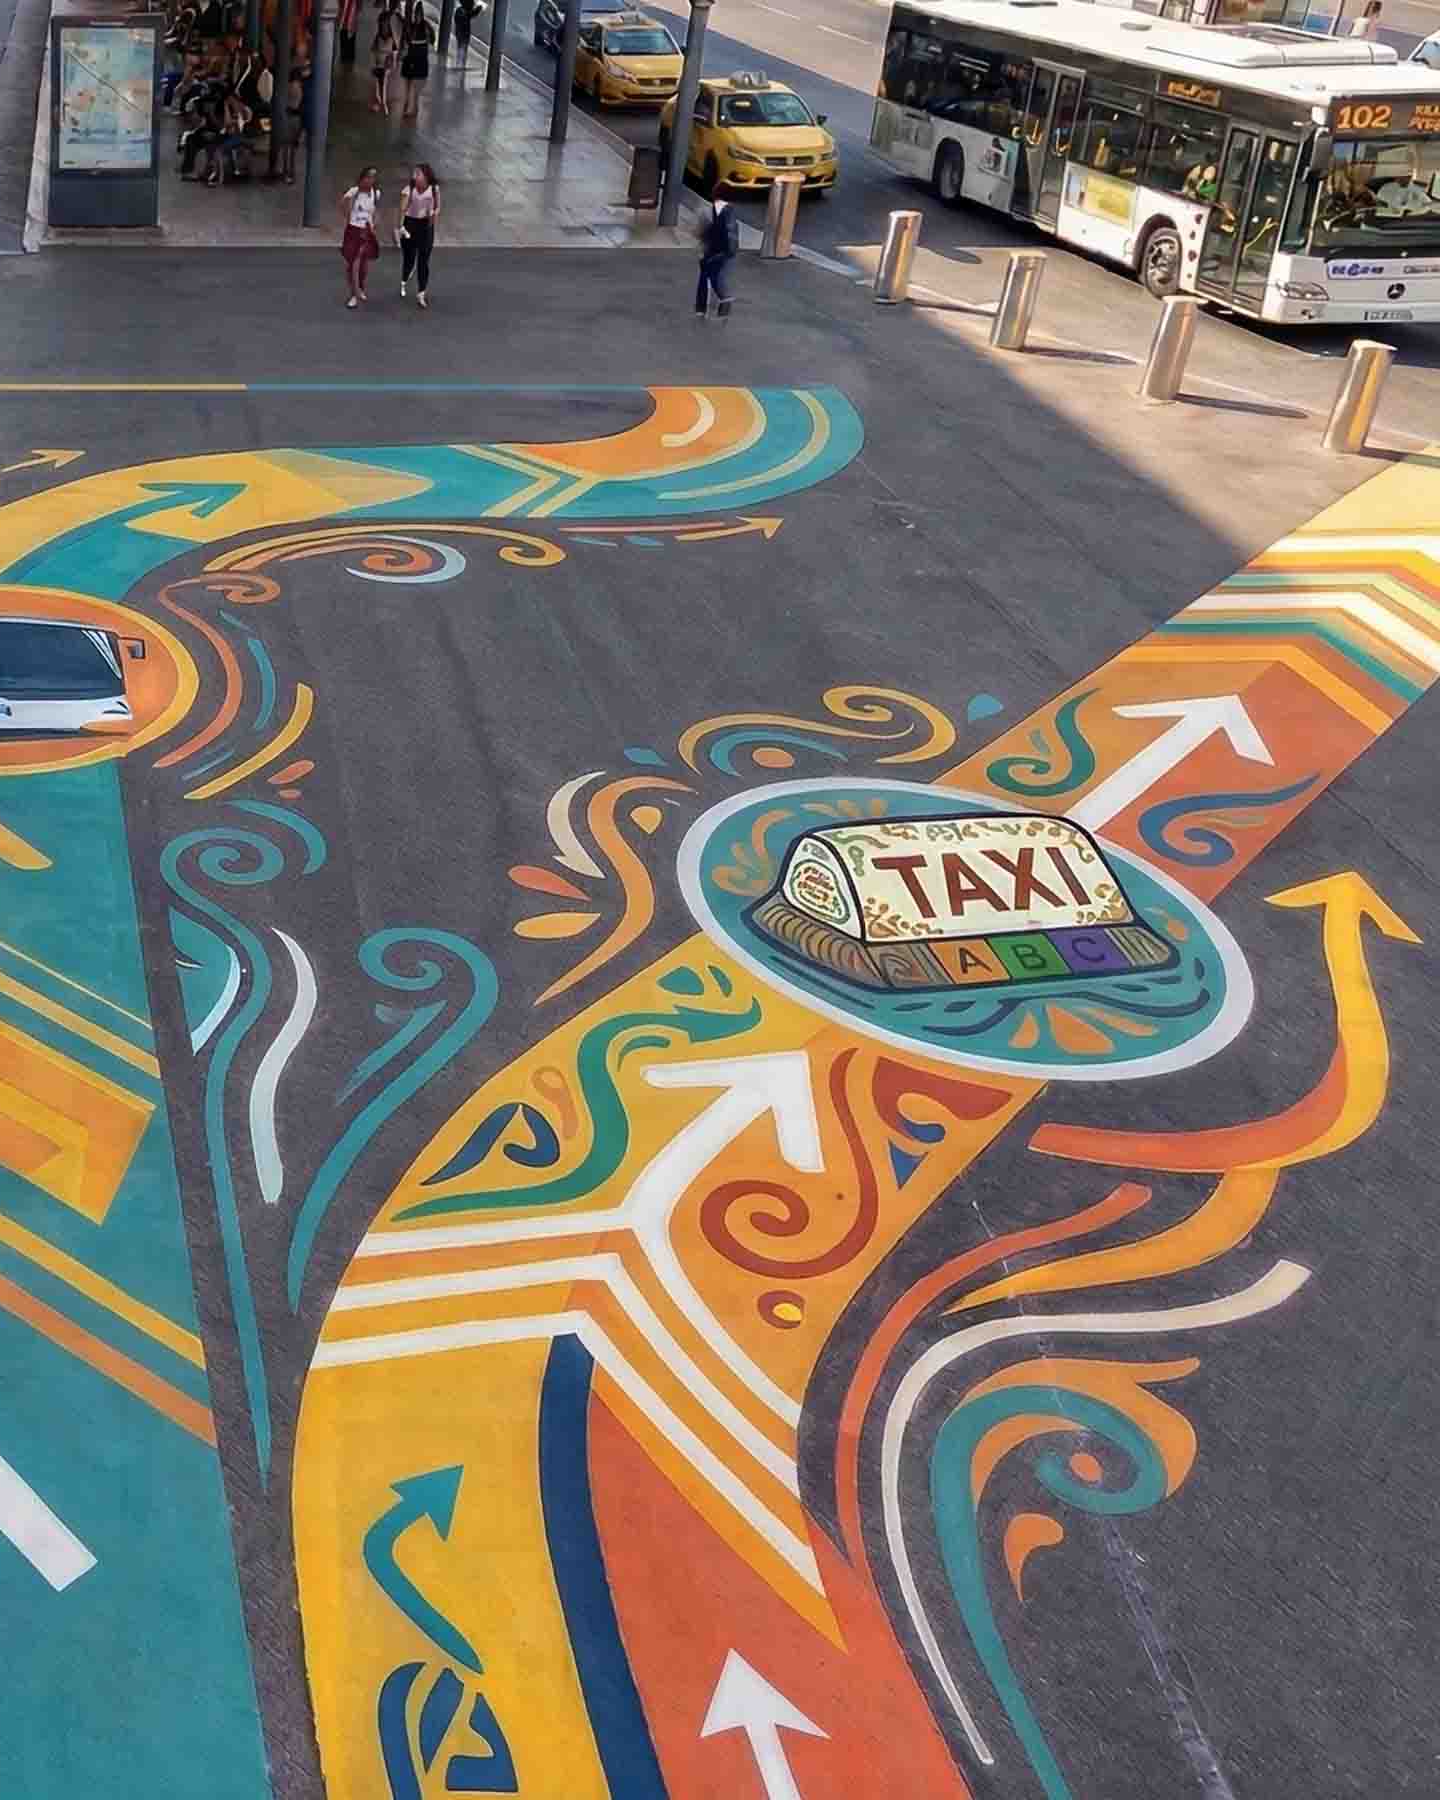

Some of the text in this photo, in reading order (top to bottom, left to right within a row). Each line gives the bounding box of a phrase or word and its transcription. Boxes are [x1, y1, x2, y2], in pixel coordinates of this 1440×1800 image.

[1337, 104, 1392, 128] 102
[871, 847, 1092, 919] TAXI
[959, 936, 1105, 974] A B C
